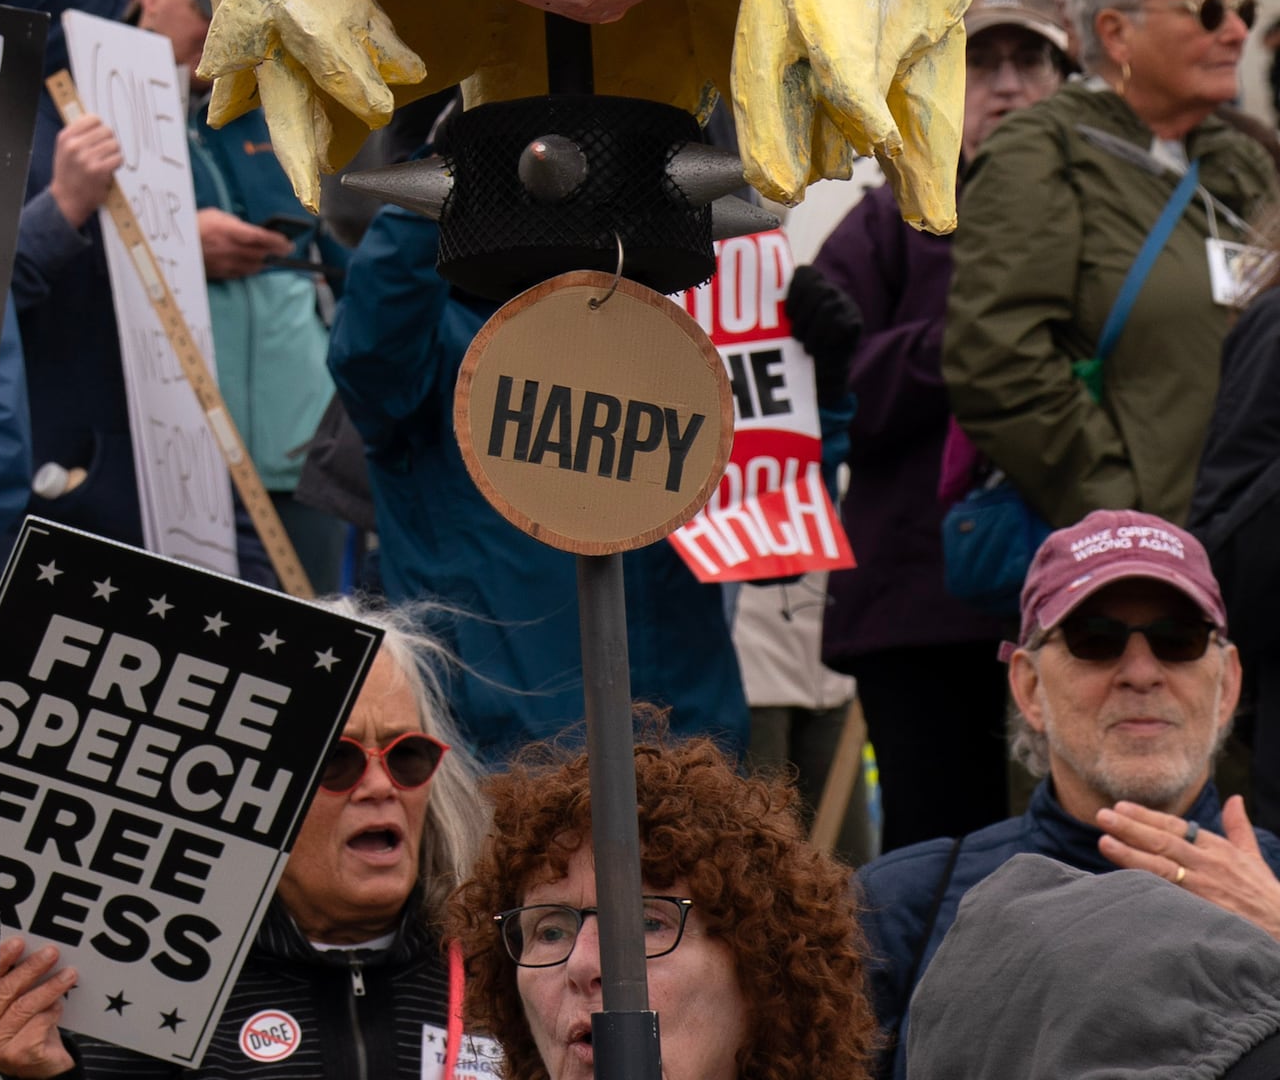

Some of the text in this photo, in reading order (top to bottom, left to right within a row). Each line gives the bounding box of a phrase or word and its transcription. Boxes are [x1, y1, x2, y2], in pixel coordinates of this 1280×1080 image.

[670, 234, 792, 336] TOP
[488, 375, 706, 493] HARPY
[726, 348, 792, 420] HE
[672, 456, 840, 576] ARCH
[1071, 529, 1112, 552] MAKE
[28, 614, 292, 751] FREE
[249, 1022, 292, 1050] DOGE
